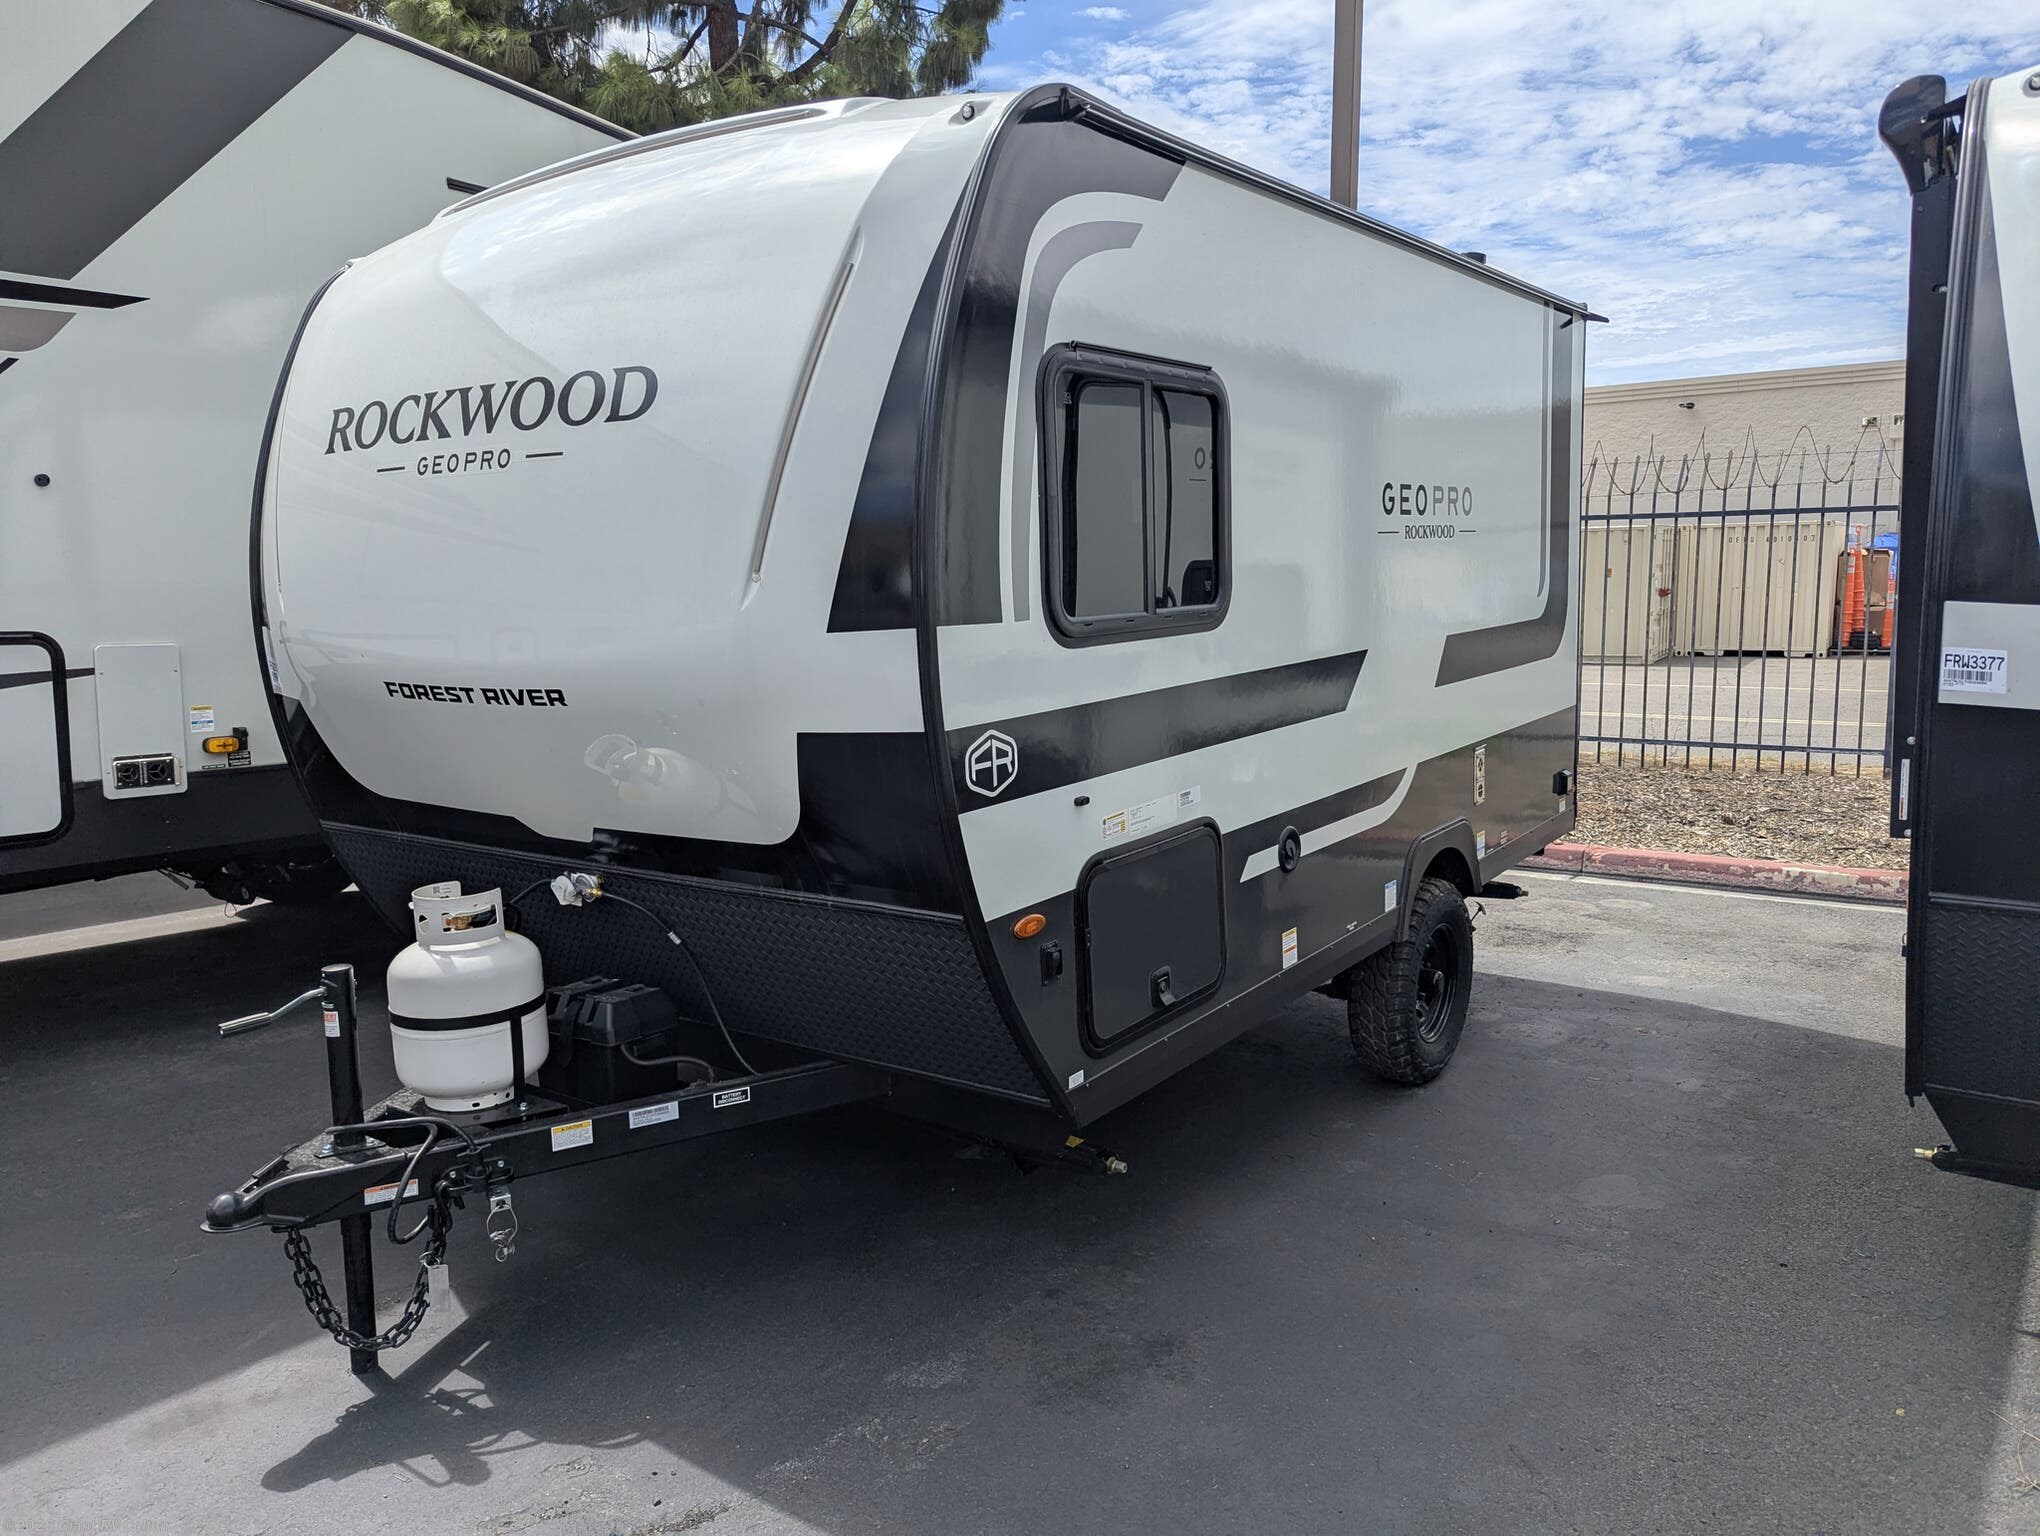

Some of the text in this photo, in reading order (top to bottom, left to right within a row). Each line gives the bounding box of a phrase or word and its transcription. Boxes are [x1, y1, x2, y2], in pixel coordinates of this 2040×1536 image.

[324, 365, 659, 456] ROCKWOOD
[416, 448, 511, 476] GEOPRO
[1382, 481, 1473, 517] GEOPRO
[1404, 524, 1455, 540] ROCKWOOD
[1944, 653, 2005, 671] FRW3377
[383, 681, 569, 707] FOREST RIVER
